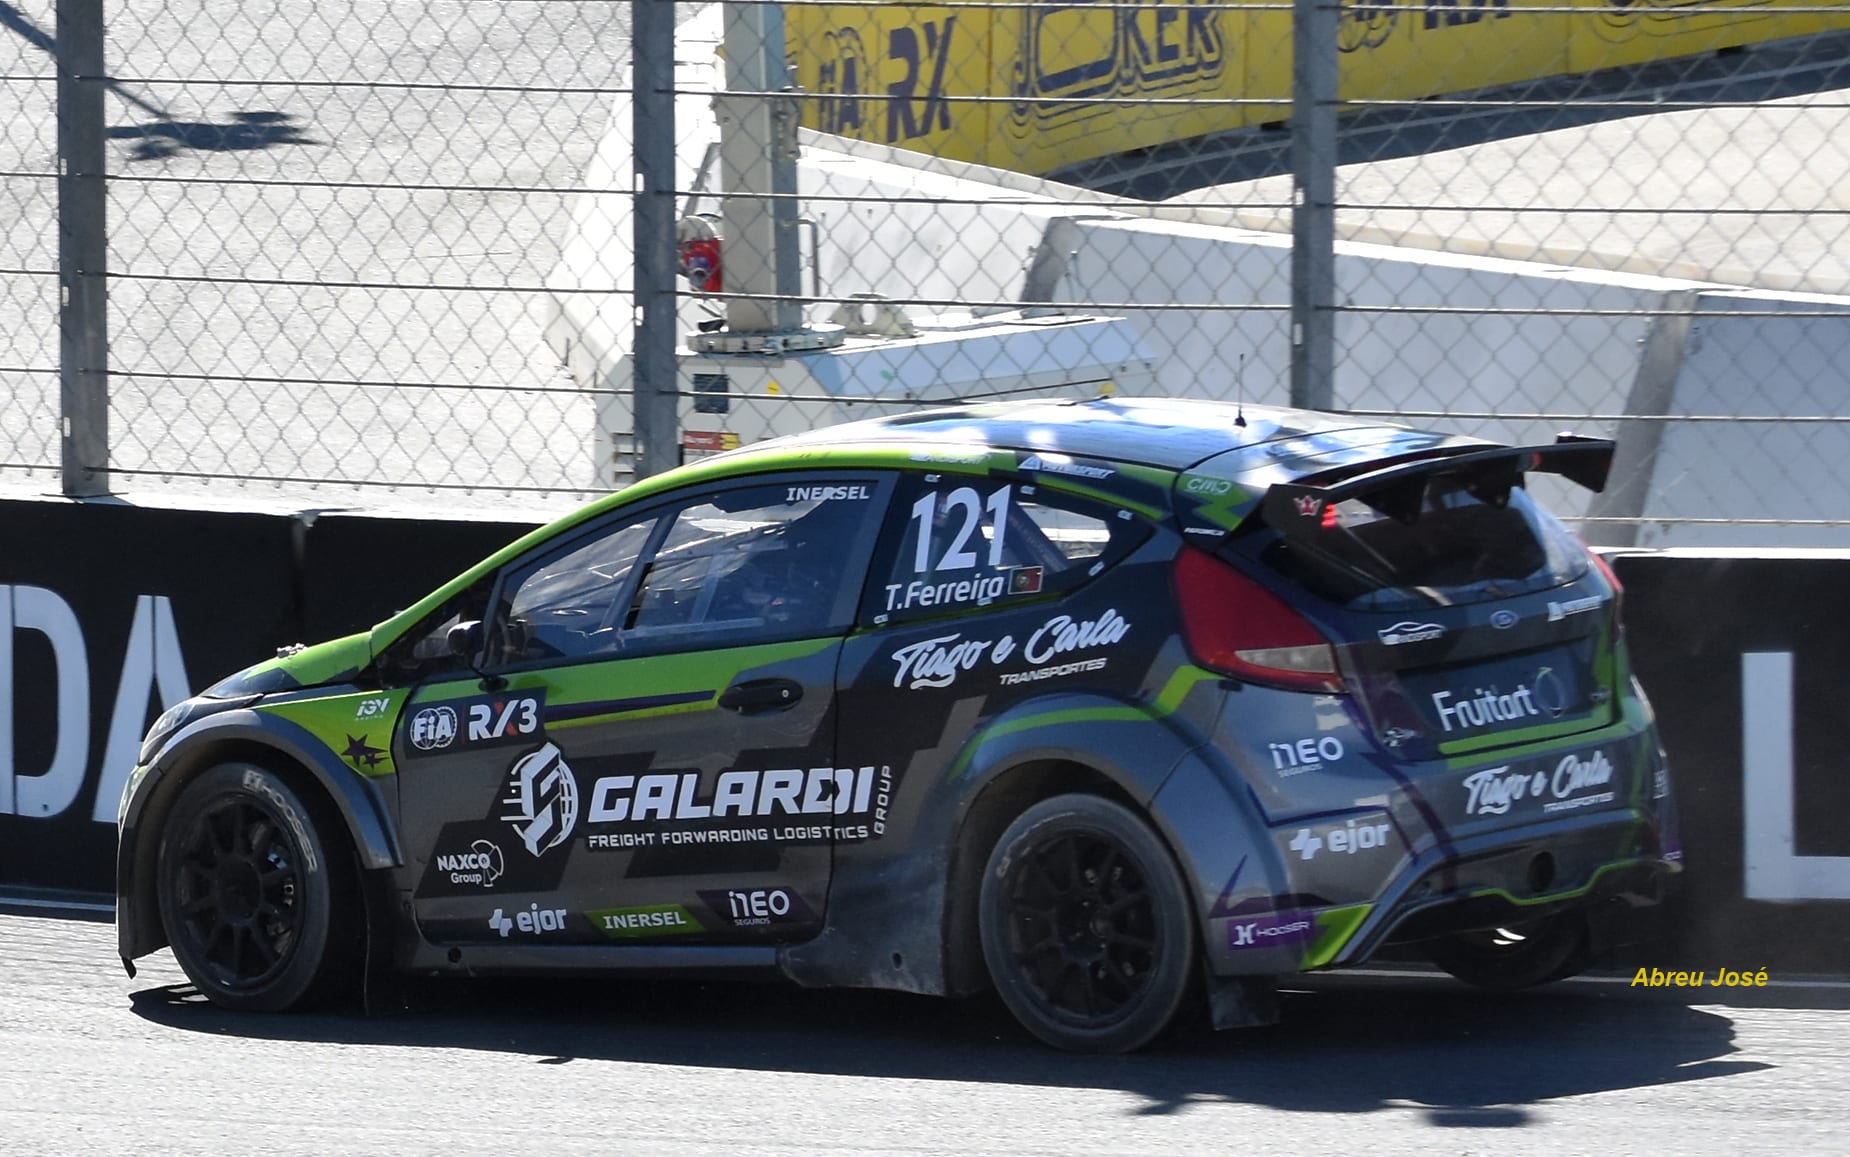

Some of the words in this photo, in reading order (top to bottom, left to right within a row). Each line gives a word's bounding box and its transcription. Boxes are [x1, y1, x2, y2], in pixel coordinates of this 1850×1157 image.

[887, 16, 957, 143] RX
[786, 486, 869, 501] INERSEL
[911, 484, 1012, 573] 121
[885, 573, 1005, 611] T.Ferreira
[891, 632, 992, 690] Tiago
[991, 634, 1016, 664] e
[1024, 608, 1131, 664] Carla
[1000, 657, 1108, 686] TRANSPORTES
[1431, 684, 1540, 731] Fruitart
[587, 766, 875, 823] GALARDI
[874, 765, 893, 834] GROUP
[589, 832, 655, 849] FREIGHT
[661, 828, 768, 845] FORWARDING
[773, 825, 869, 841] LOGISTICS
[1327, 819, 1391, 855] ejor
[436, 853, 491, 871] NAXCO
[450, 872, 482, 885] Group
[516, 903, 567, 935] ejor
[602, 911, 686, 929] INERSEL
